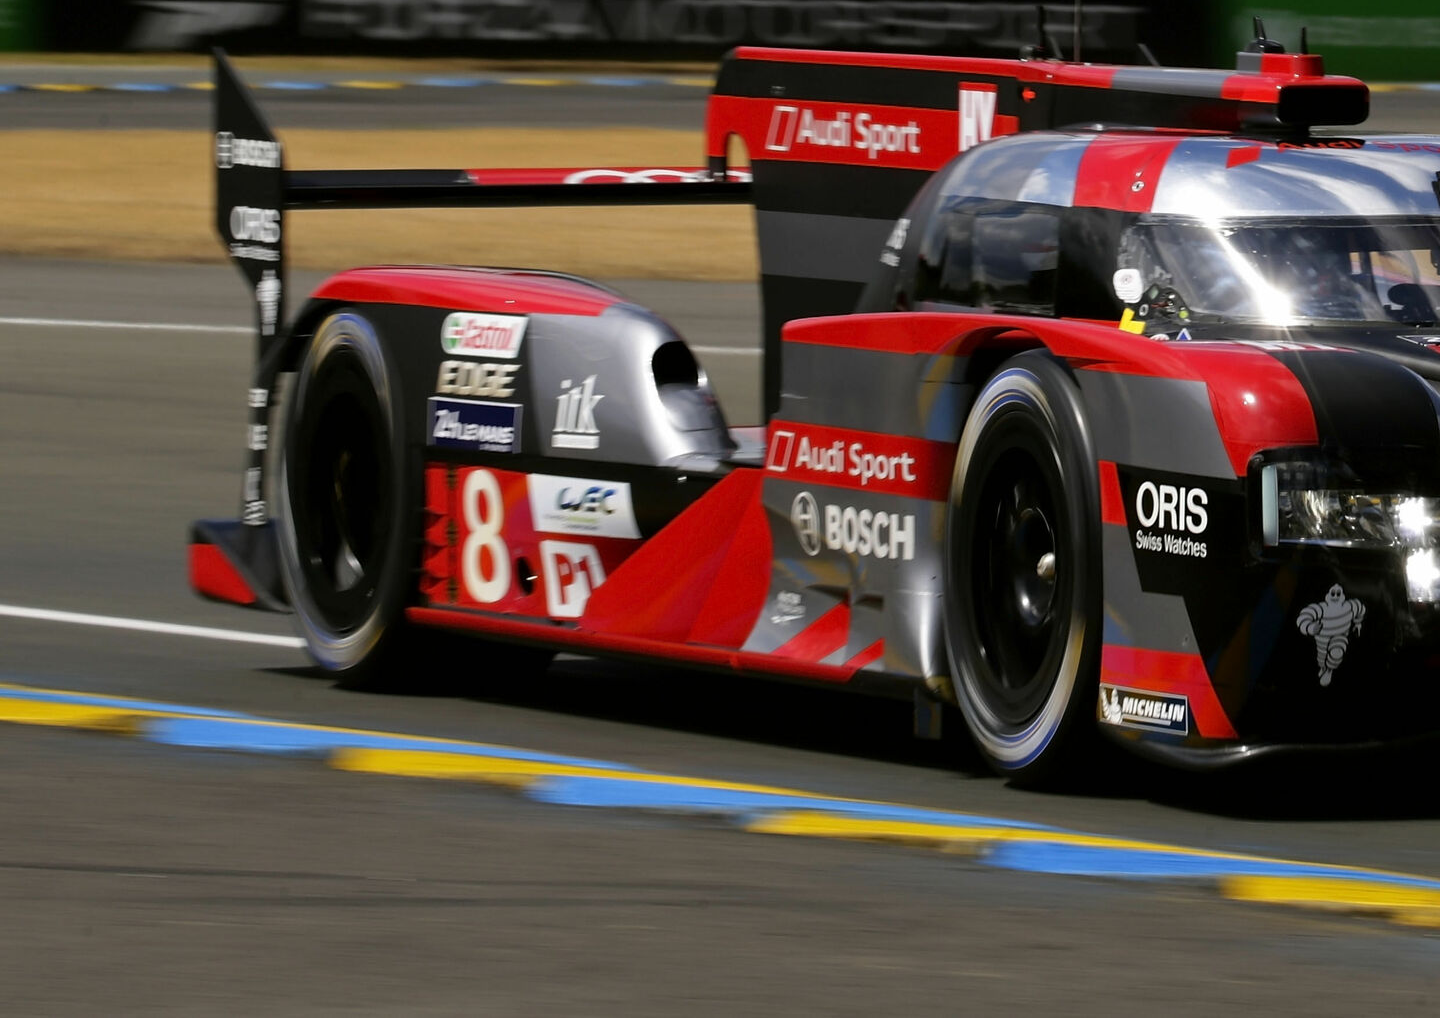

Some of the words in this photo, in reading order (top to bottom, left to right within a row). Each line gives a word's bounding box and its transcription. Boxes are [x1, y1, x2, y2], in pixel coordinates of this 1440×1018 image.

[797, 108, 850, 147] Audi
[854, 112, 921, 159] Sport
[1277, 139, 1366, 153] Audi
[436, 360, 522, 398] EDGE
[796, 436, 845, 473] Audi
[848, 442, 917, 486] Sport
[824, 504, 916, 560] BOSCH
[1136, 481, 1208, 534] ORIS
[461, 469, 512, 604] 8
[1135, 529, 1163, 552] Swiss
[1164, 534, 1208, 558] Watches
[1122, 695, 1185, 723] MICHELIN
